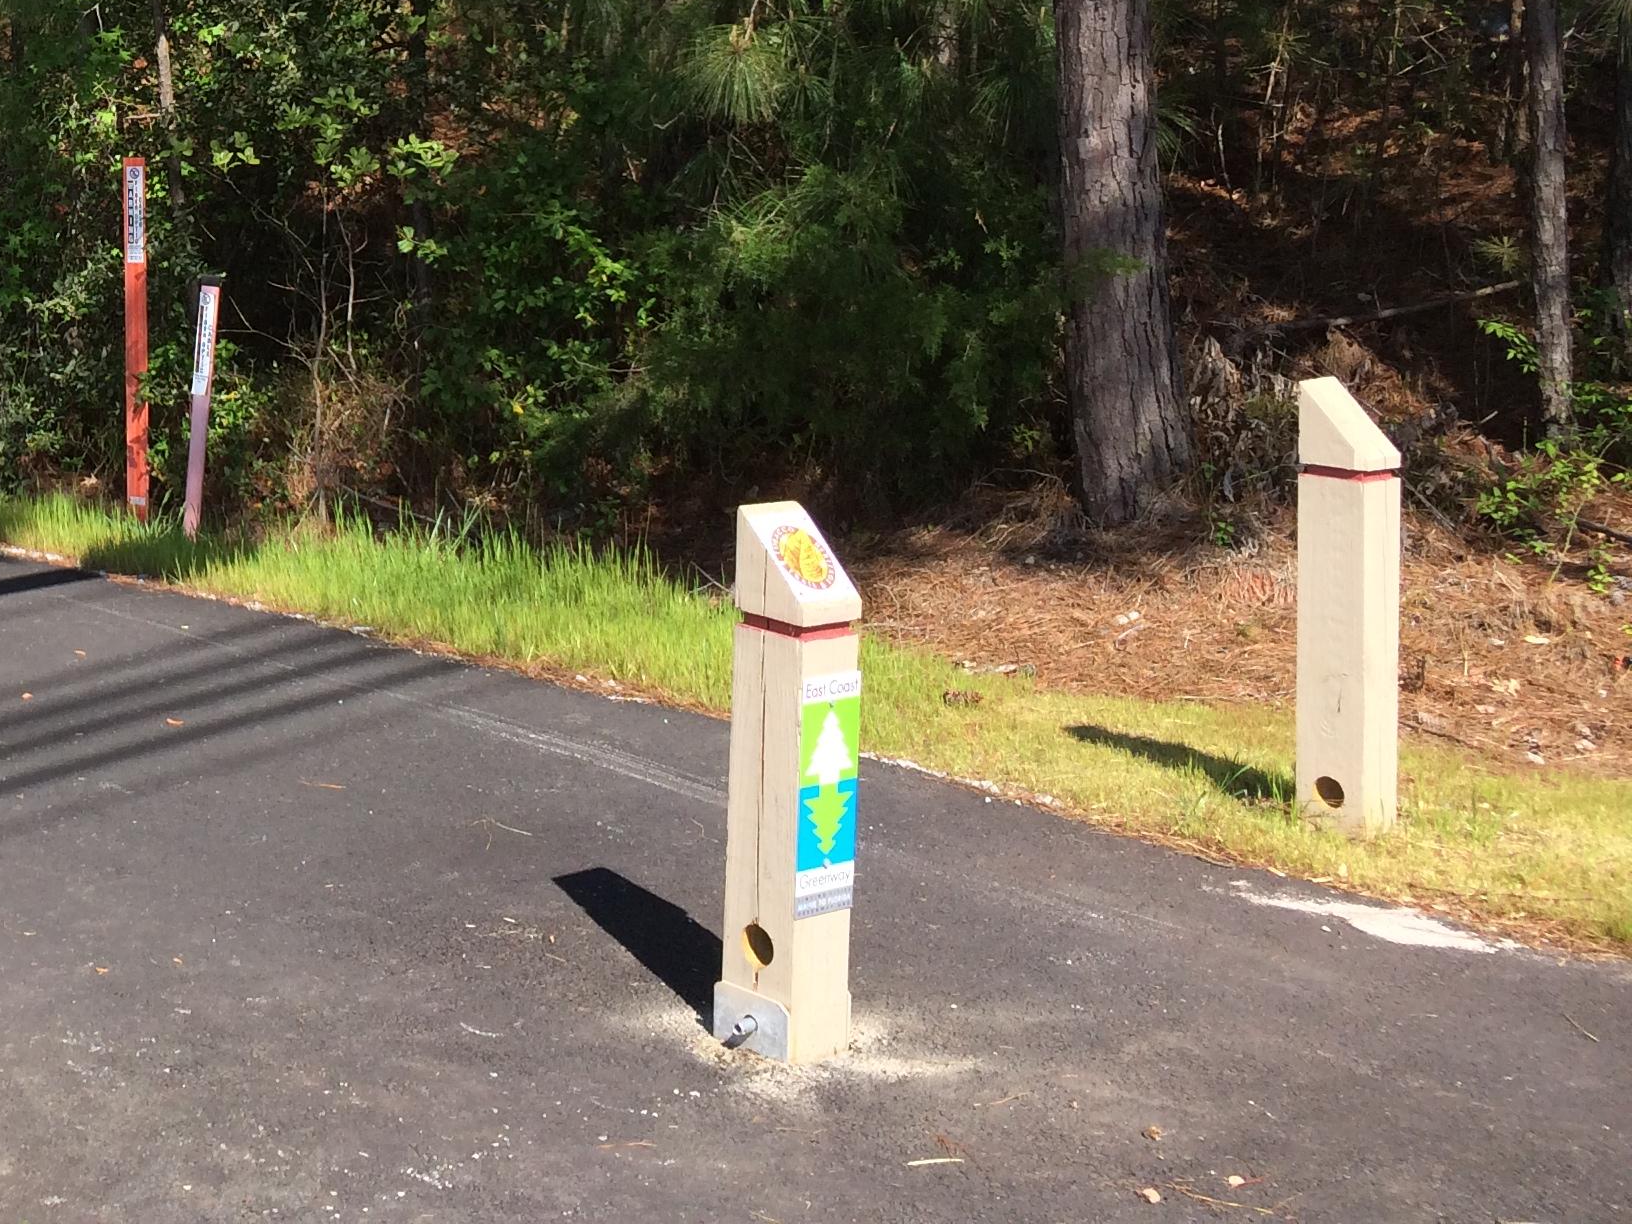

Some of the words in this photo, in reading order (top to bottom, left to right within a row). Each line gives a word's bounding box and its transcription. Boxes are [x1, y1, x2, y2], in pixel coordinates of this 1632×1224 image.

[806, 683, 826, 698] East
[829, 678, 858, 695] Coast
[799, 871, 850, 889] Greenway
